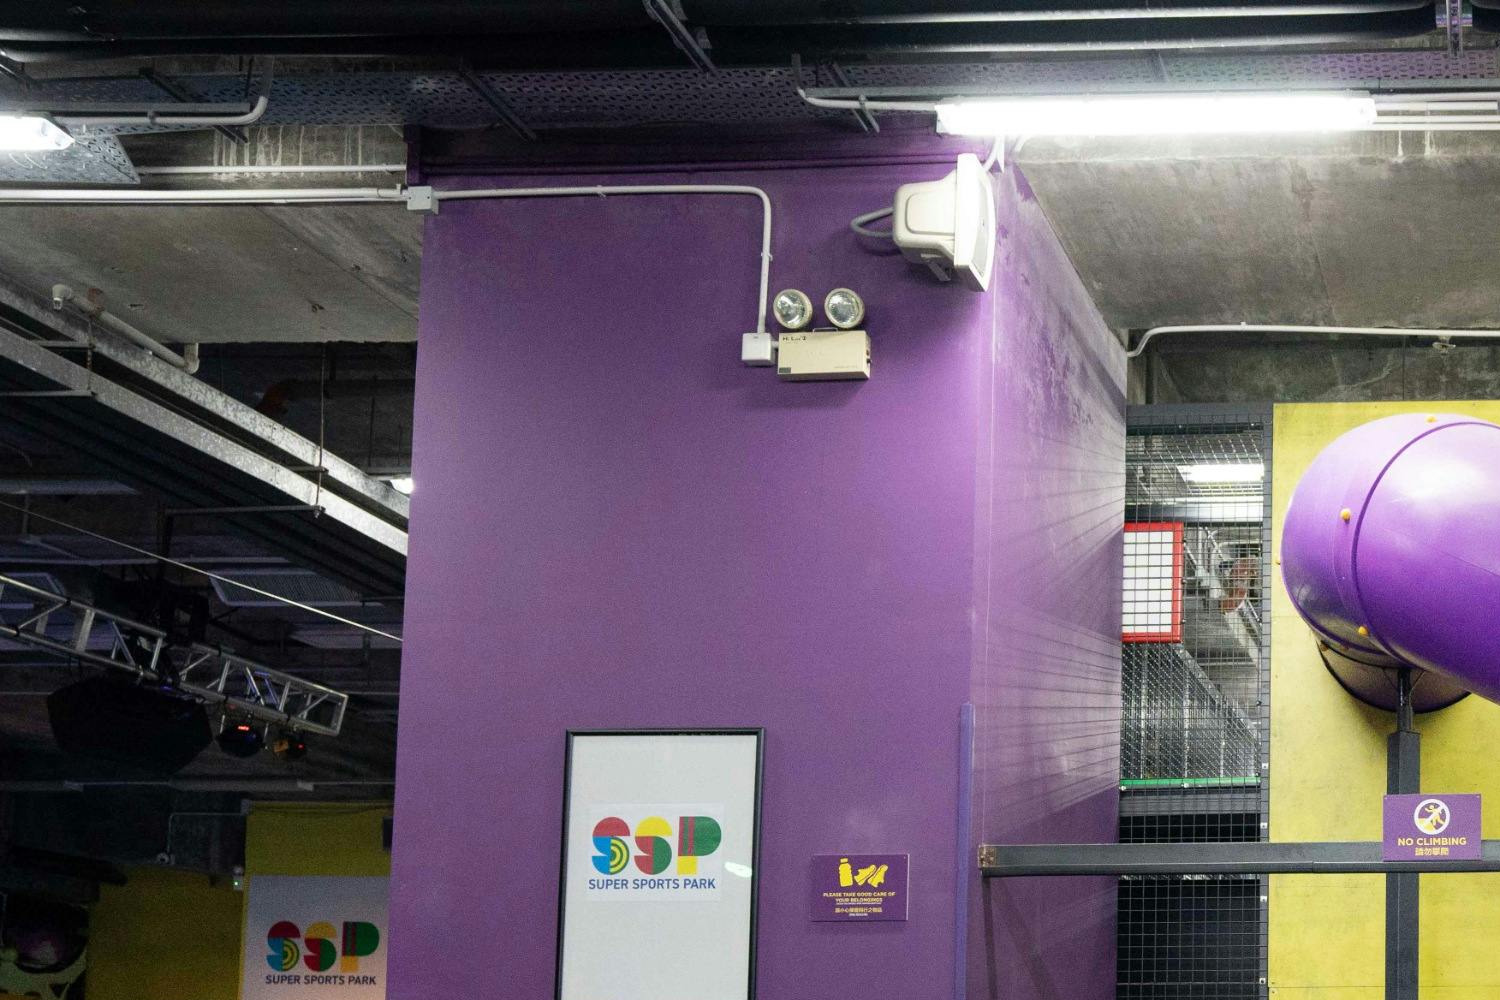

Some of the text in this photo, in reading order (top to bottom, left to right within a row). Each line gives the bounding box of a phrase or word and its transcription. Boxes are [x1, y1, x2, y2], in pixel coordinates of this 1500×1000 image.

[591, 815, 722, 876] SSP
[1397, 837, 1467, 846] NO CLIMBING
[588, 878, 716, 890] SUPER SPORTS PARK
[266, 920, 380, 973] SSP
[265, 974, 377, 985] SUPER SPORTS PARK
